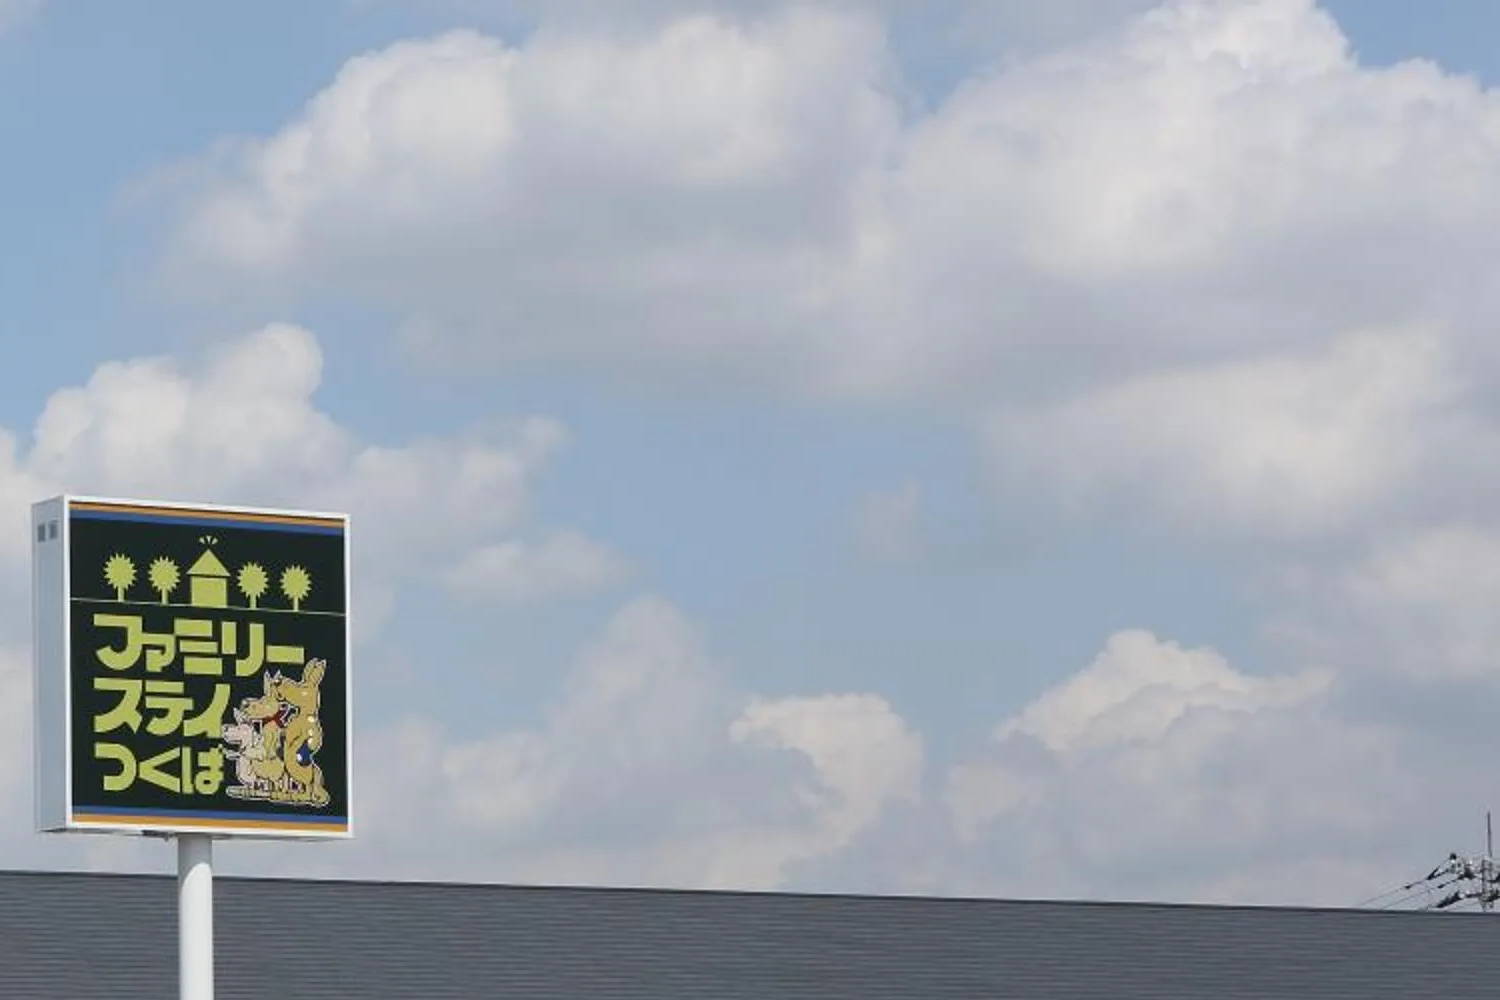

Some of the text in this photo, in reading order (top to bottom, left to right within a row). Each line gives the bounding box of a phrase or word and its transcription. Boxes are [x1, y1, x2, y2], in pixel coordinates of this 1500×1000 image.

[93, 613, 305, 677] ファミリー
